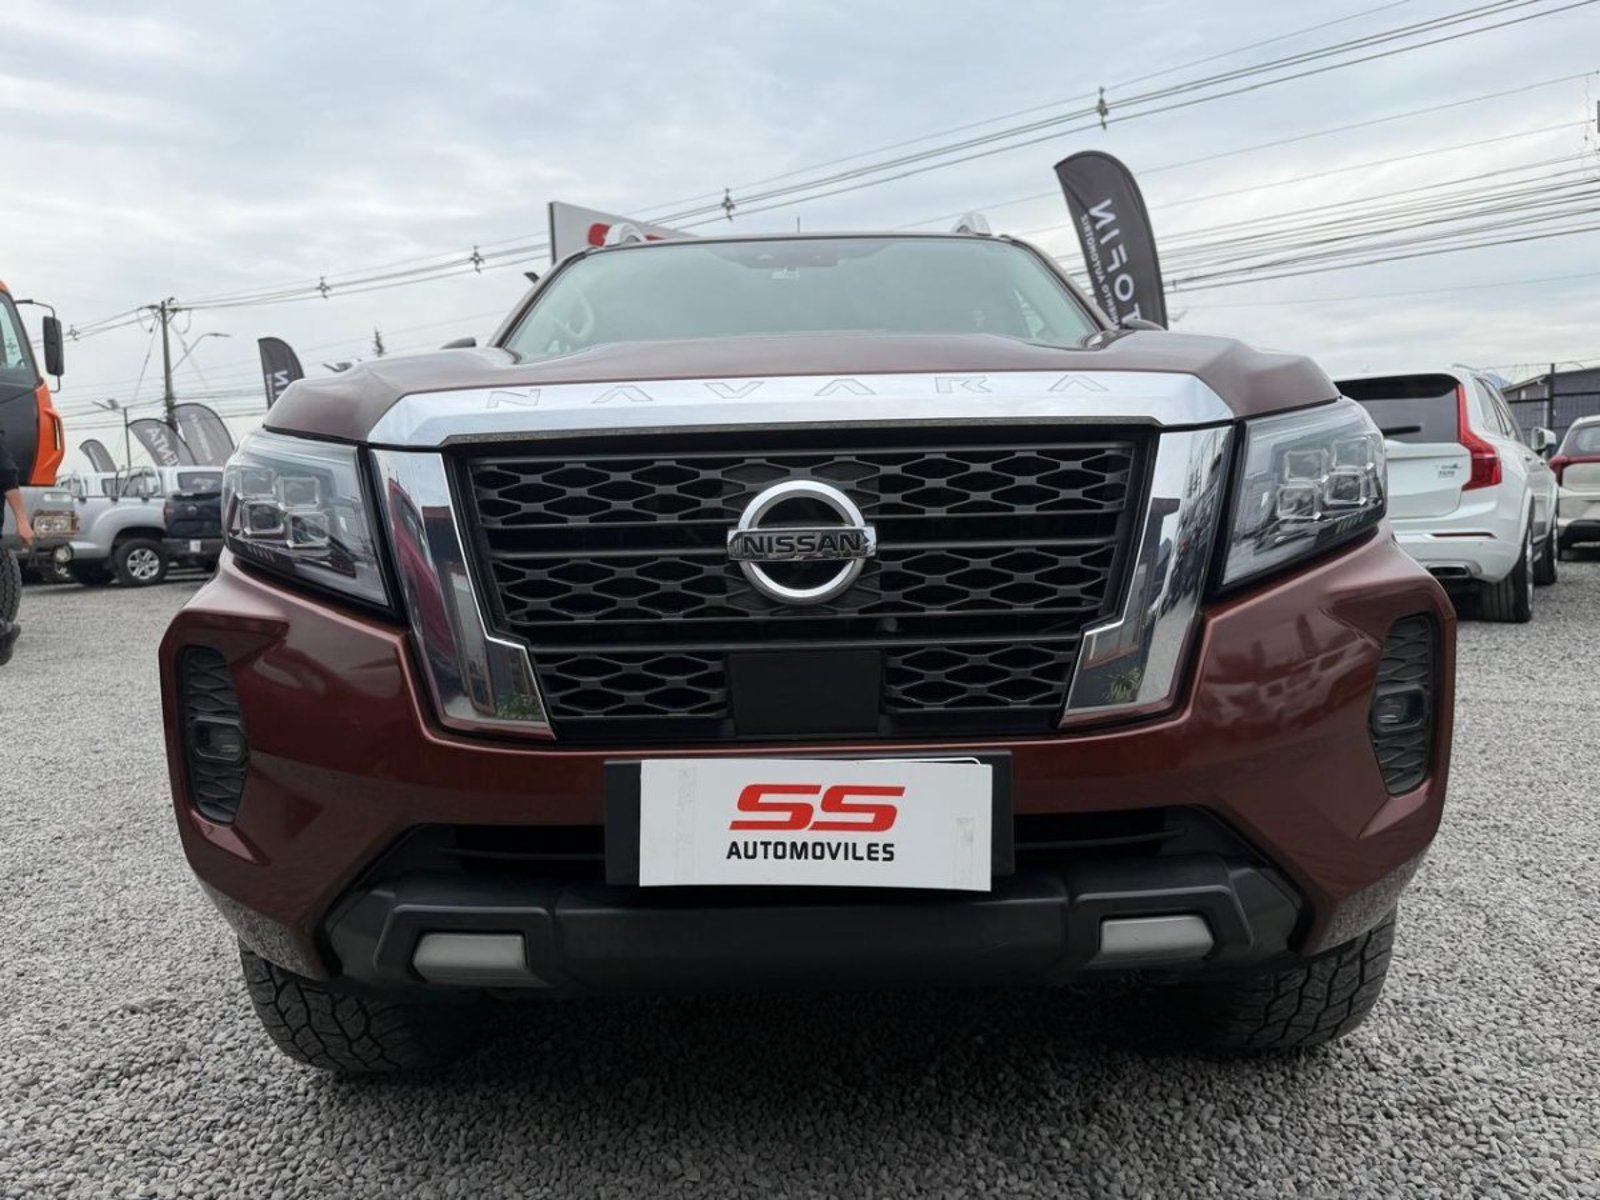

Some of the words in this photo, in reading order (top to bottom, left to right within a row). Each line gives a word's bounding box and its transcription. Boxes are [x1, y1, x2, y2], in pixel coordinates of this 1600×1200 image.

[485, 374, 1110, 409] NAVARA
[743, 534, 862, 554] NISSAN
[728, 783, 906, 832] SS
[726, 841, 895, 862] AUTOMOVILES
